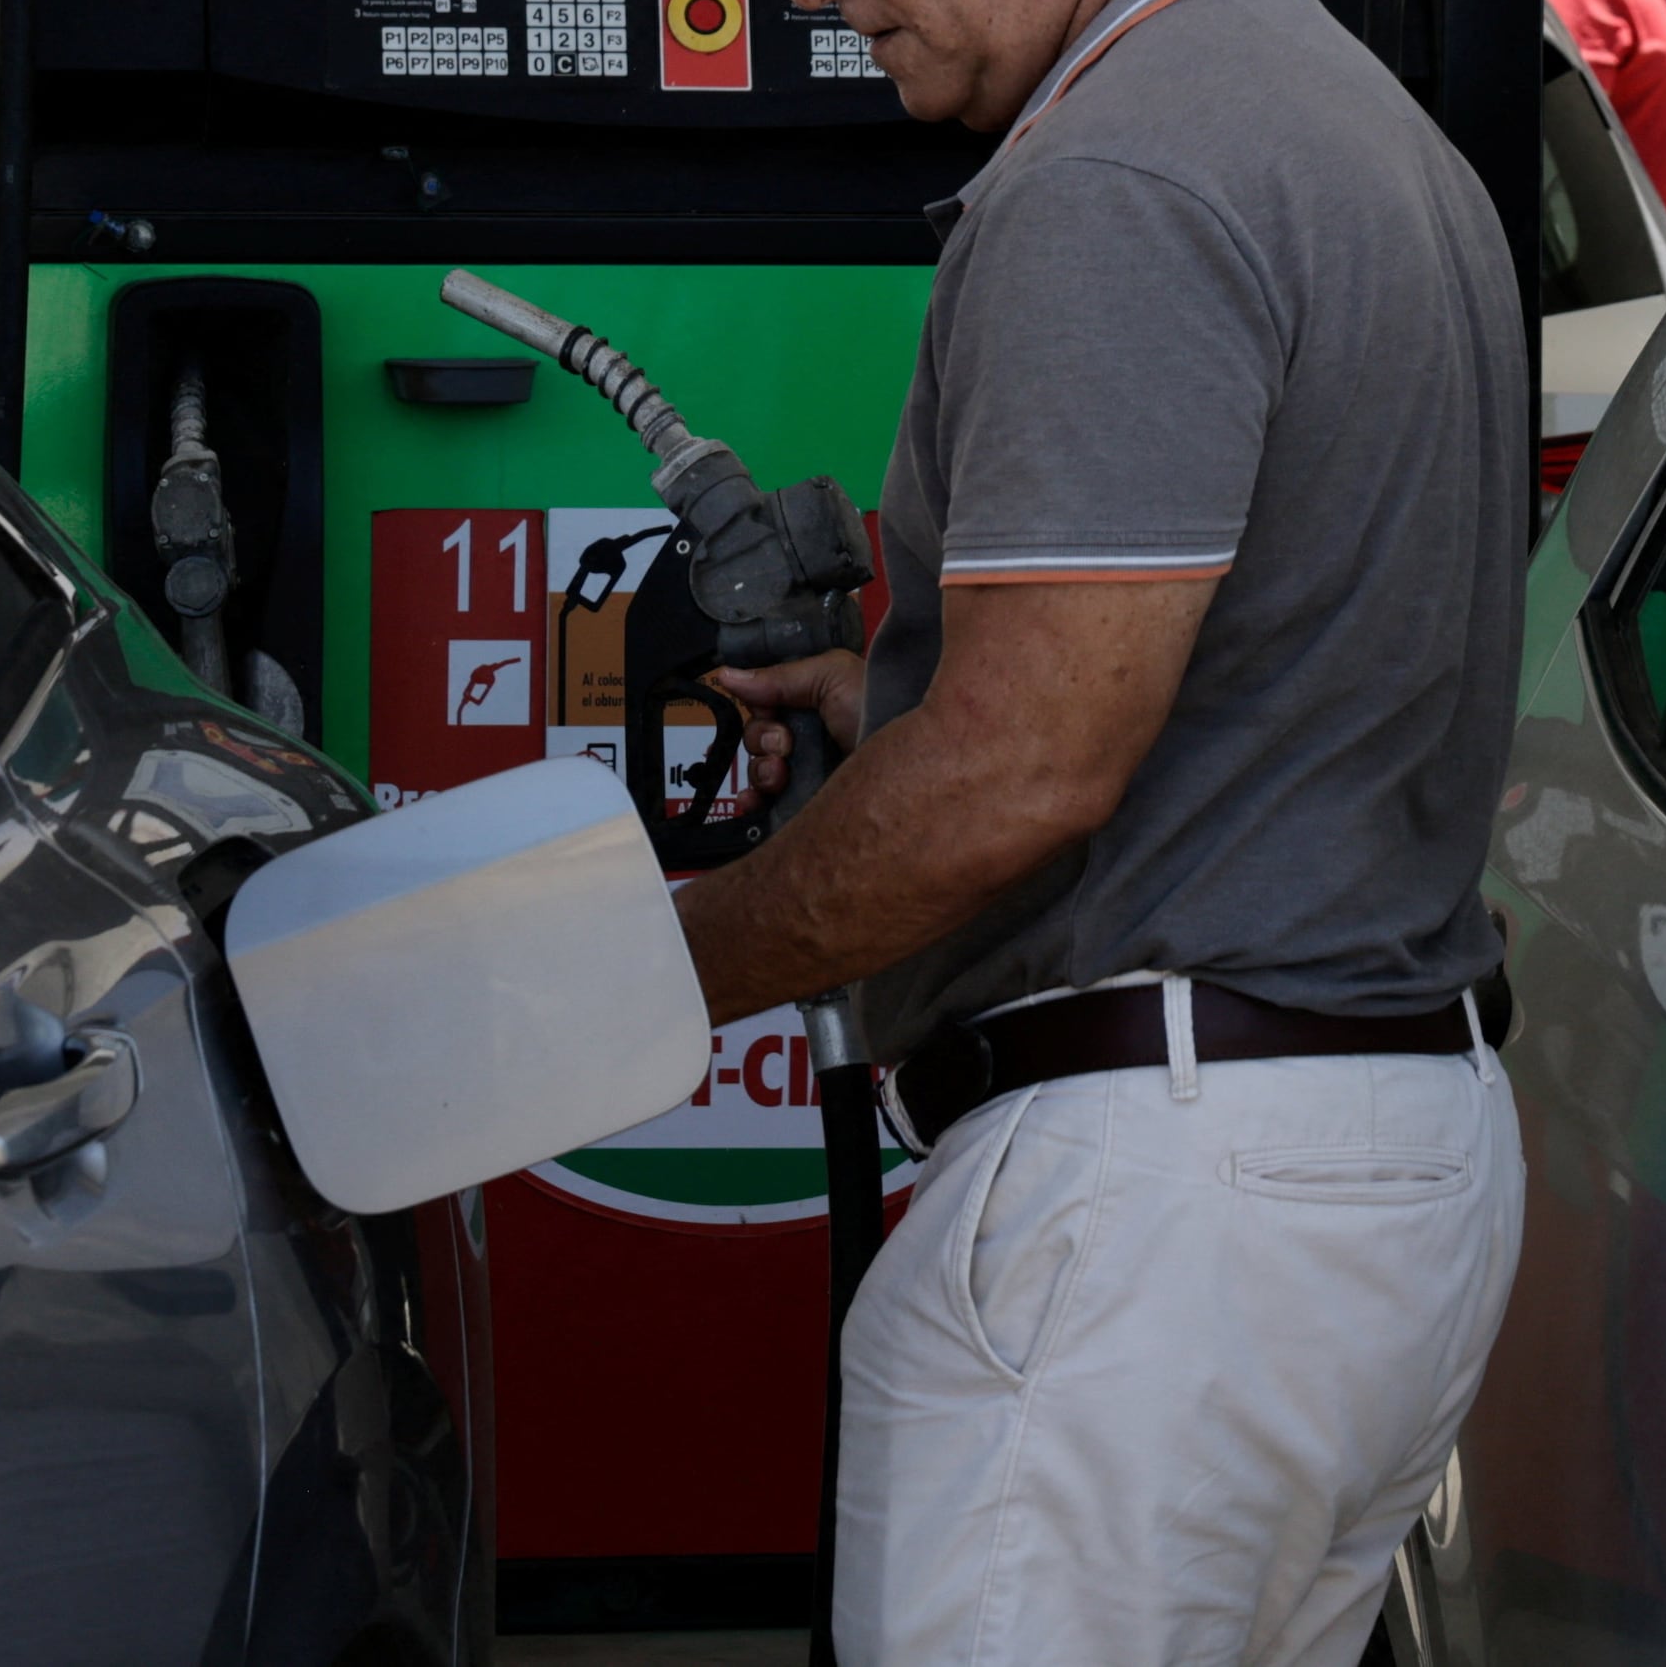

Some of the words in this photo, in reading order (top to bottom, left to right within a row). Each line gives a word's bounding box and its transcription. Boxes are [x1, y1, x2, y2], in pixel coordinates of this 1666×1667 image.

[533, 8, 543, 23] 4
[558, 8, 569, 23] 5
[583, 8, 594, 23] 6
[606, 10, 621, 21] F2
[385, 33, 401, 45] P1
[411, 33, 429, 45] P2
[436, 33, 454, 45] P3
[461, 33, 479, 45] P4
[487, 33, 505, 45] P5
[534, 32, 541, 47] 1
[558, 32, 569, 47] 2
[583, 32, 595, 47] 3
[607, 35, 622, 45] F3
[814, 35, 830, 46] P1
[839, 35, 857, 47] P2
[385, 57, 404, 70] P6
[411, 58, 429, 70] P7
[437, 58, 454, 70] P8
[462, 58, 480, 70] P9
[486, 58, 507, 70] P10
[534, 57, 545, 72] 0
[557, 56, 572, 73] C
[608, 59, 623, 70] F4
[815, 60, 832, 71] P6
[840, 60, 857, 72] P7
[443, 518, 527, 612] 11
[597, 673, 624, 686] coloc
[595, 693, 623, 706] obtur
